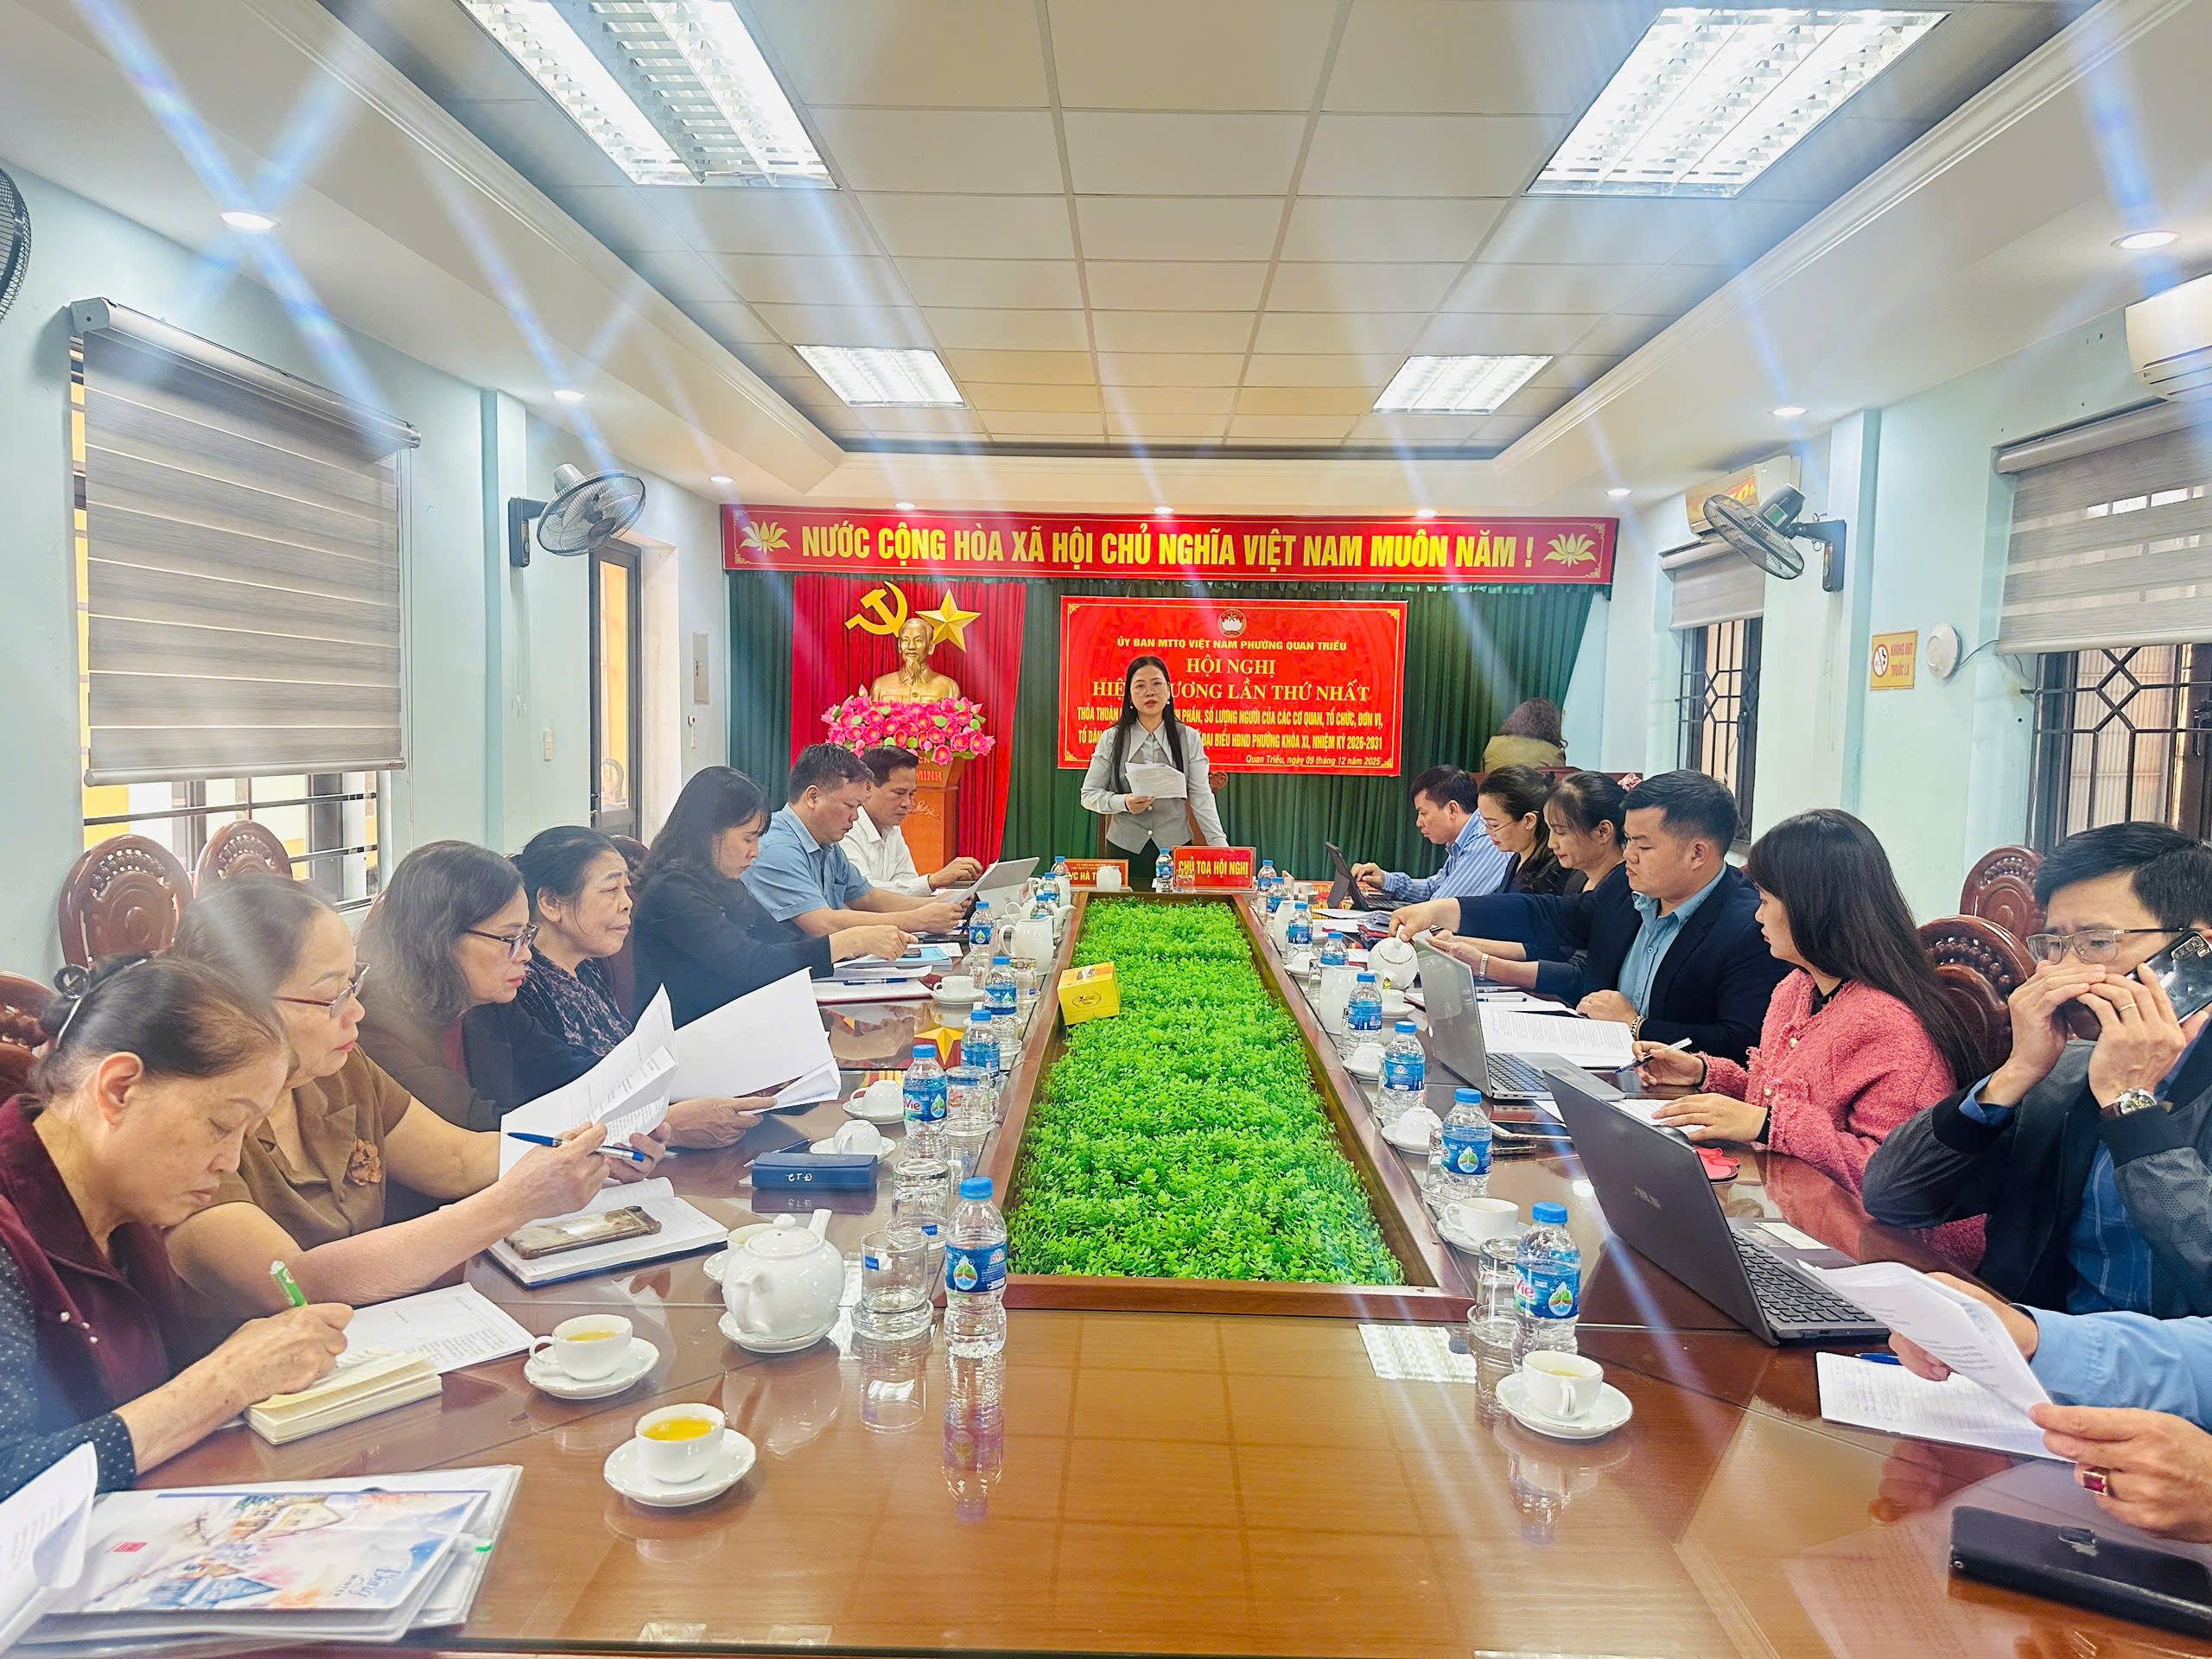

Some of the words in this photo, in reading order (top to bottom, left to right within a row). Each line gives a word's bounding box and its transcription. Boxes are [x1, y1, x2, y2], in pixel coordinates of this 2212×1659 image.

[801, 520, 870, 558] NƯỚC
[878, 521, 947, 566] CỘNG
[953, 522, 1005, 562] HÒA
[1010, 524, 1045, 563] XÃ
[1052, 524, 1094, 570] HỘI
[1101, 522, 1152, 564] CHỦ
[1159, 526, 1236, 566] NGHĨA
[1243, 527, 1296, 572] VIỆT
[1302, 534, 1363, 568] NAM
[1370, 527, 1449, 568] MUÔN
[1454, 528, 1517, 568] NĂM
[1524, 536, 1535, 569] !
[1117, 636, 1130, 647] ỦY
[1133, 639, 1155, 648] BAN
[1158, 639, 1186, 650] MTTQ
[1188, 638, 1211, 650] VIỆT
[1212, 640, 1238, 650] NAM
[1240, 639, 1283, 651] PHƯỜNG
[1286, 641, 1314, 652] QUAN
[1185, 654, 1222, 678] HỘI
[1226, 659, 1276, 679] NGHỊ
[1092, 677, 1125, 701] HIỆ
[1172, 683, 1223, 699] ƯƠNG
[1228, 677, 1267, 701] LẦN
[1271, 681, 1313, 701] THỨ
[1316, 679, 1370, 702] NHẤT
[1077, 702, 1095, 721] THỎA
[1096, 704, 1119, 725] THUẬN
[1205, 705, 1214, 724] SỐ
[1215, 708, 1238, 727] LƯỢNG
[1238, 707, 1261, 725] NGƯỜI
[1262, 706, 1275, 726] CỦA
[1277, 709, 1291, 726] CÁC
[1293, 710, 1302, 726] CƠ
[1303, 711, 1324, 728] QUAN,
[1357, 710, 1373, 727] ĐƠN
[1202, 732, 1214, 750] ĐẠI
[1252, 730, 1281, 748] PHƯỜNG
[1281, 732, 1300, 749] KHÓA
[1301, 734, 1311, 751] XI,
[1312, 732, 1335, 753] NHIỆM
[1346, 735, 1382, 751] 2026-2031
[1245, 754, 1264, 764] Quan
[1287, 755, 1305, 766] ngày
[1306, 756, 1314, 765] 09
[1315, 756, 1336, 767] tháng
[1338, 756, 1346, 766] 12
[1347, 756, 1363, 766] năm
[1364, 756, 1381, 766] 2025
[1178, 856, 1195, 878] CHỦ
[1197, 861, 1211, 878] TOẠ
[1213, 858, 1227, 878] HỘI
[1229, 861, 1249, 878] NGHỊ
[903, 1099, 921, 1111] Vie
[1515, 1279, 1535, 1299] Vie
